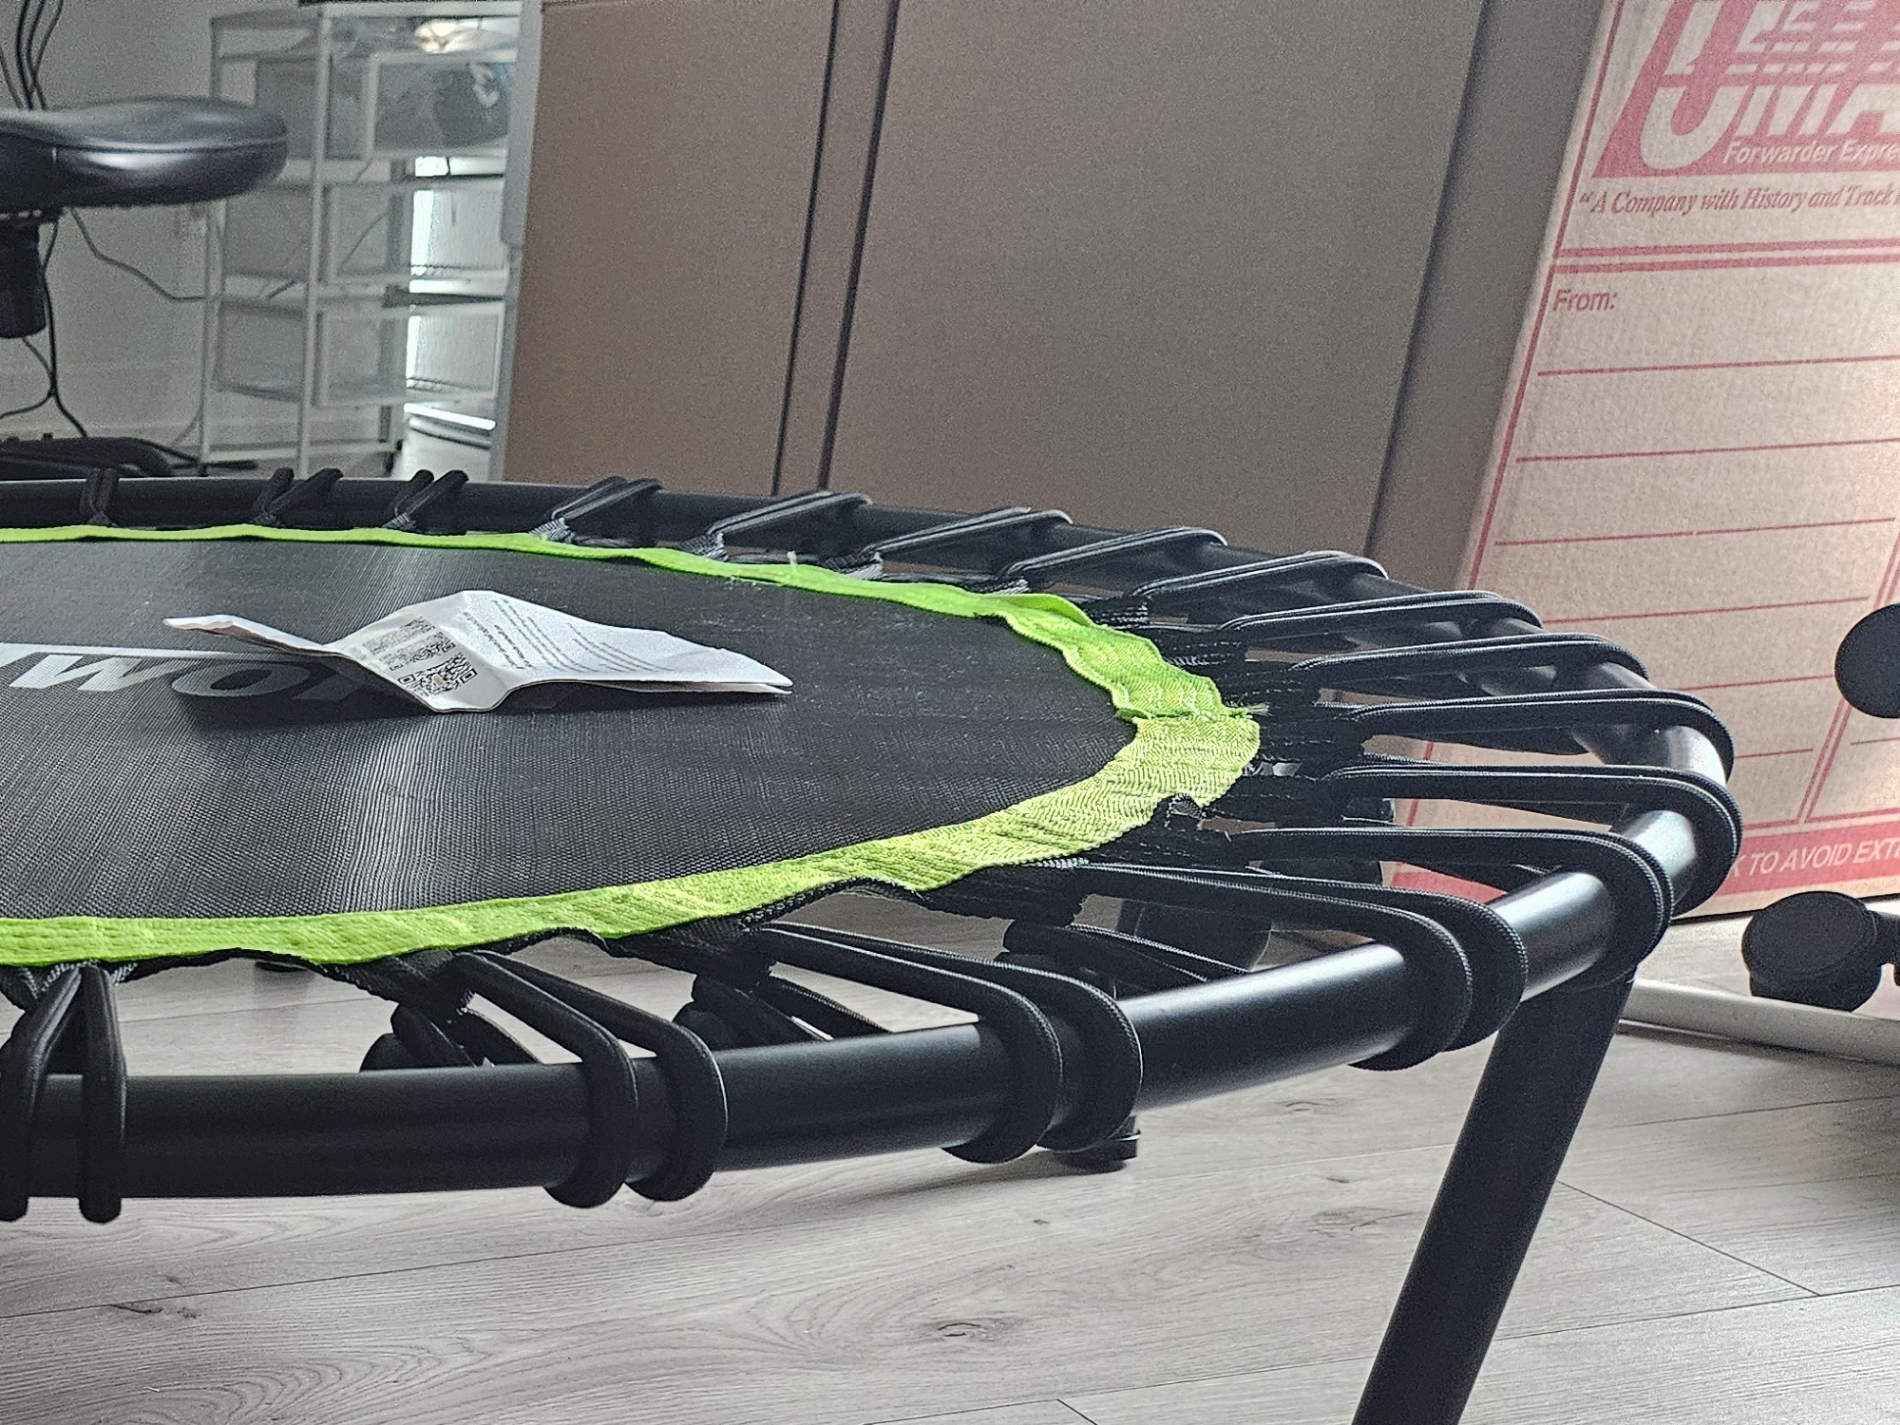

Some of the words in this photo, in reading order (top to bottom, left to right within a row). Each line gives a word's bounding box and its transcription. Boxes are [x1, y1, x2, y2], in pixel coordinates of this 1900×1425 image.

[1722, 139, 1838, 165] Forwarder
[1611, 189, 1698, 218] Company
[1700, 187, 1740, 211] with
[1740, 186, 1807, 213] History
[1807, 184, 1845, 208] and
[1844, 183, 1896, 207] Track
[1552, 288, 1618, 311] From:
[1749, 850, 1779, 877] TO
[1780, 843, 1852, 872] AVOID
